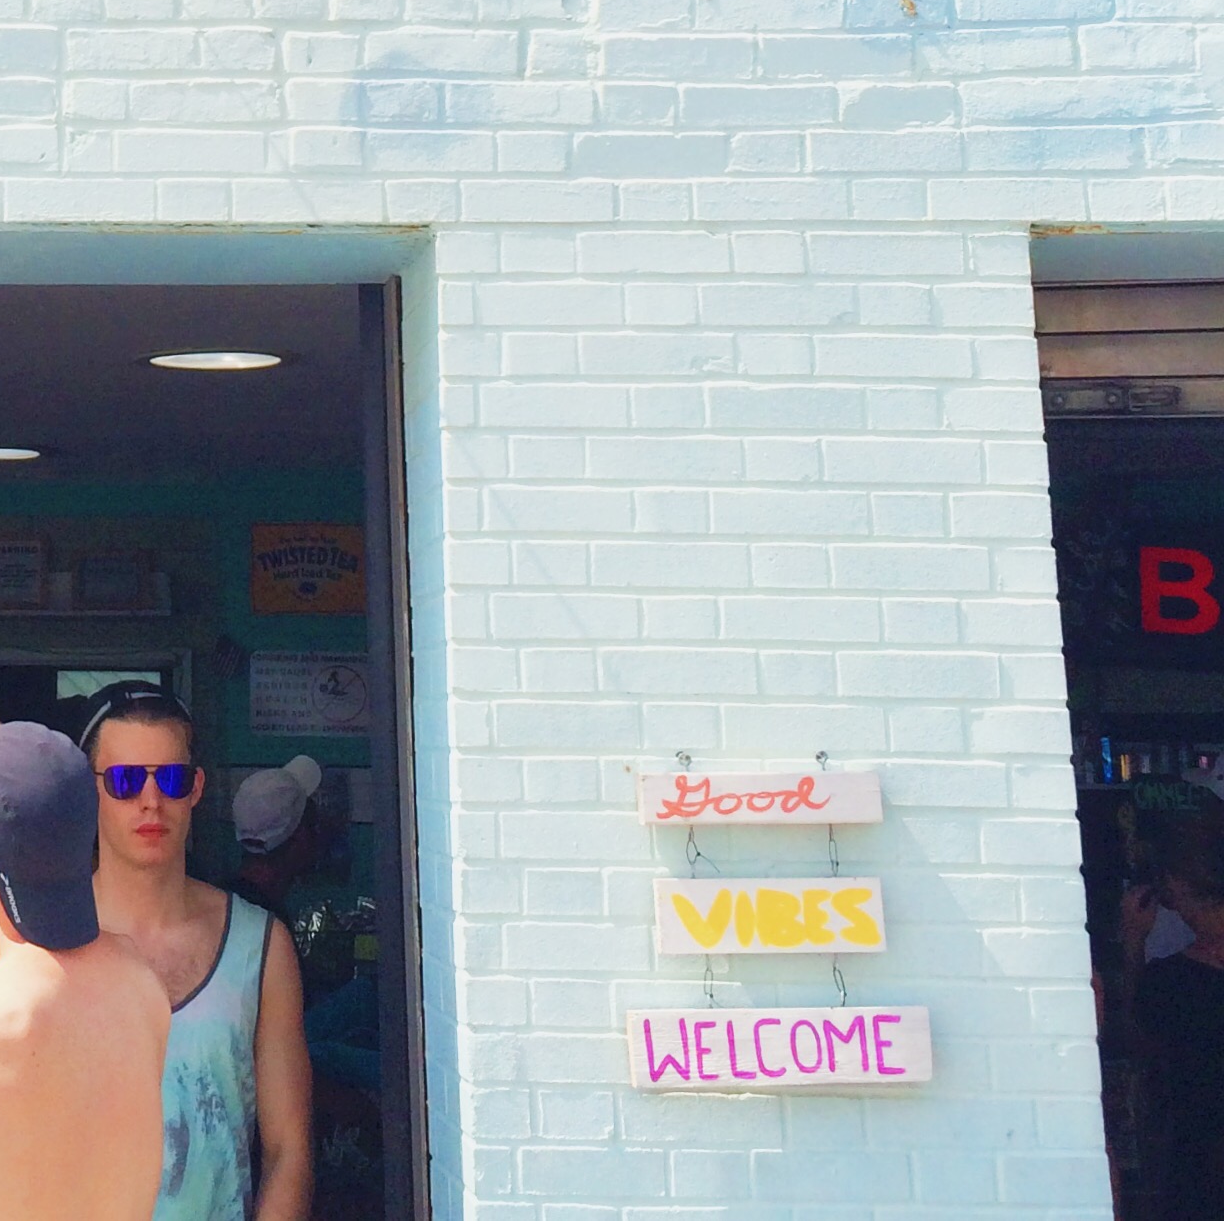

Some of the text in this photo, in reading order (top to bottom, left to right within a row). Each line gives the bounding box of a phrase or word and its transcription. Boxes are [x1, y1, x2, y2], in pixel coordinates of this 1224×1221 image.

[257, 546, 359, 574] TWISTED TEA
[1139, 546, 1221, 635] B
[656, 775, 831, 820] Good
[671, 887, 883, 950] VIBES
[643, 1014, 907, 1083] WELCOME
